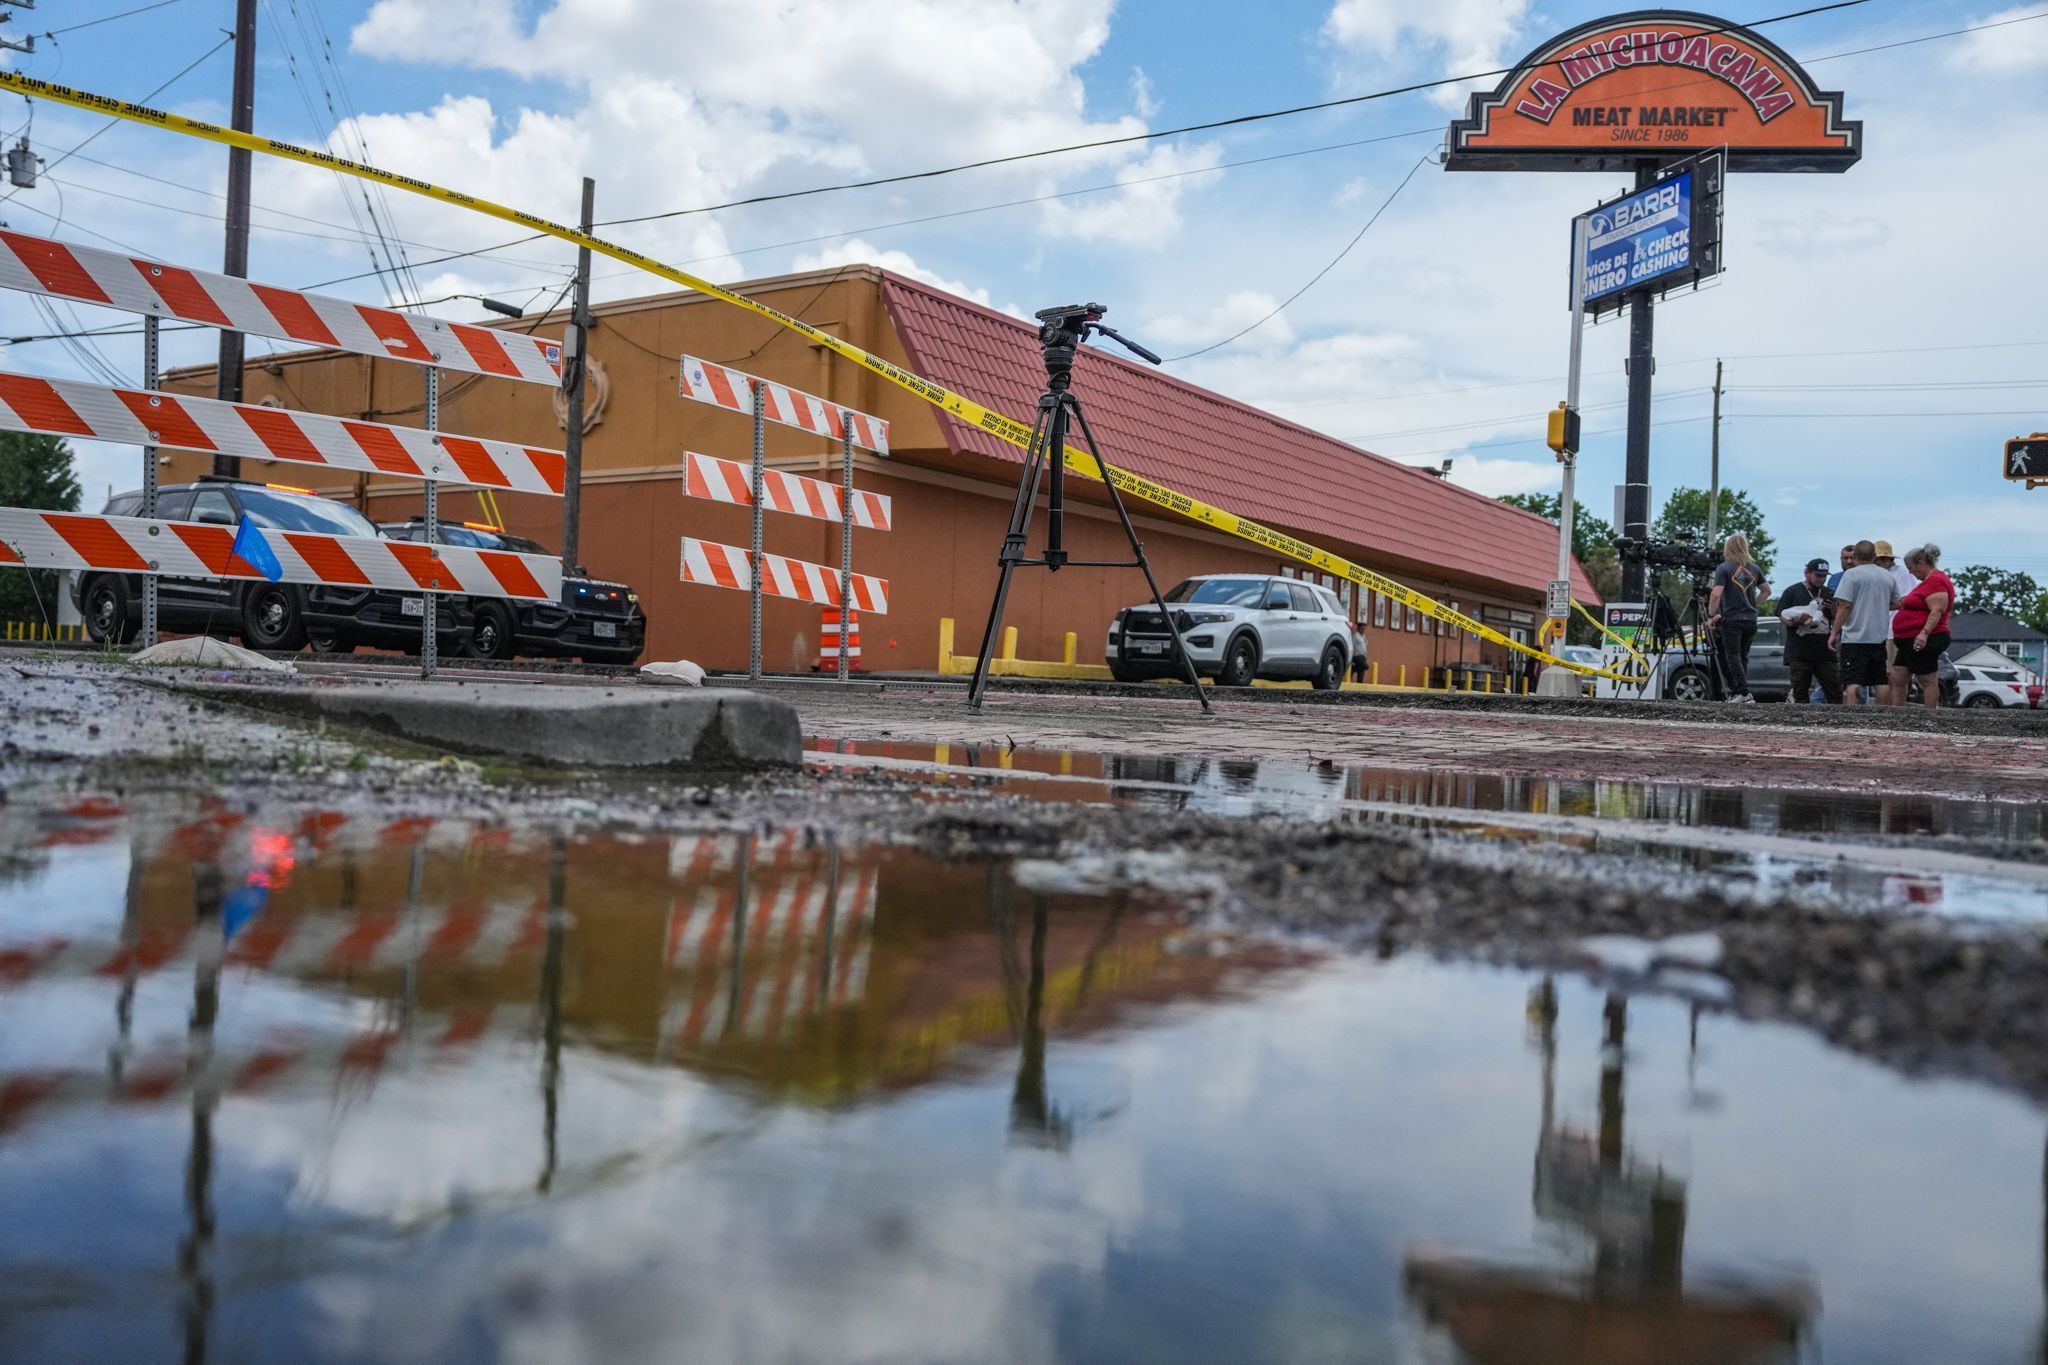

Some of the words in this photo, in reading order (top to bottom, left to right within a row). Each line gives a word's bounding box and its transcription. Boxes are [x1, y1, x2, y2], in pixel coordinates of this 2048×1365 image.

[1515, 78, 1570, 123] LA
[1559, 31, 1795, 122] MICHOACANA
[1572, 107, 1632, 127] MEAT
[1610, 129, 1653, 142] SINCE
[1656, 129, 1689, 142] 1986
[1614, 183, 1679, 229] BARRI
[1648, 228, 1690, 257] CHECK
[1614, 252, 1628, 270] DE
[1631, 247, 1689, 279] CASHING
[1583, 267, 1627, 296] INERO
[862, 355, 885, 371] CROSS
[883, 366, 898, 379] NOT
[896, 373, 908, 384] DO
[905, 379, 927, 394] SCENE
[924, 389, 945, 404] CRIME
[979, 418, 997, 431] CROSS
[982, 411, 1002, 425] CRUZAR
[995, 425, 1007, 436] NOT
[1013, 433, 1028, 446] SCENE
[1103, 465, 1127, 480] CRUZA
[1125, 475, 1136, 484] NO
[1122, 481, 1137, 492] NOT
[1136, 479, 1160, 494] CRIMEN
[1137, 487, 1148, 496] DO
[1148, 491, 1170, 505] SCENE
[1159, 489, 1171, 498] DEL
[1169, 493, 1193, 507] ESCENA
[1168, 500, 1191, 514] CRIME
[1235, 525, 1256, 539] CROSS
[1236, 519, 1259, 533] CRUZAR
[1256, 527, 1267, 536] NO
[1255, 533, 1268, 544] NOT
[1266, 530, 1286, 543] CRIMEN
[1267, 538, 1277, 547] DO
[1284, 537, 1295, 547] DEL
[1277, 542, 1295, 554] SCENE
[1294, 541, 1313, 554] ESCENA
[1294, 548, 1313, 561] CRIME
